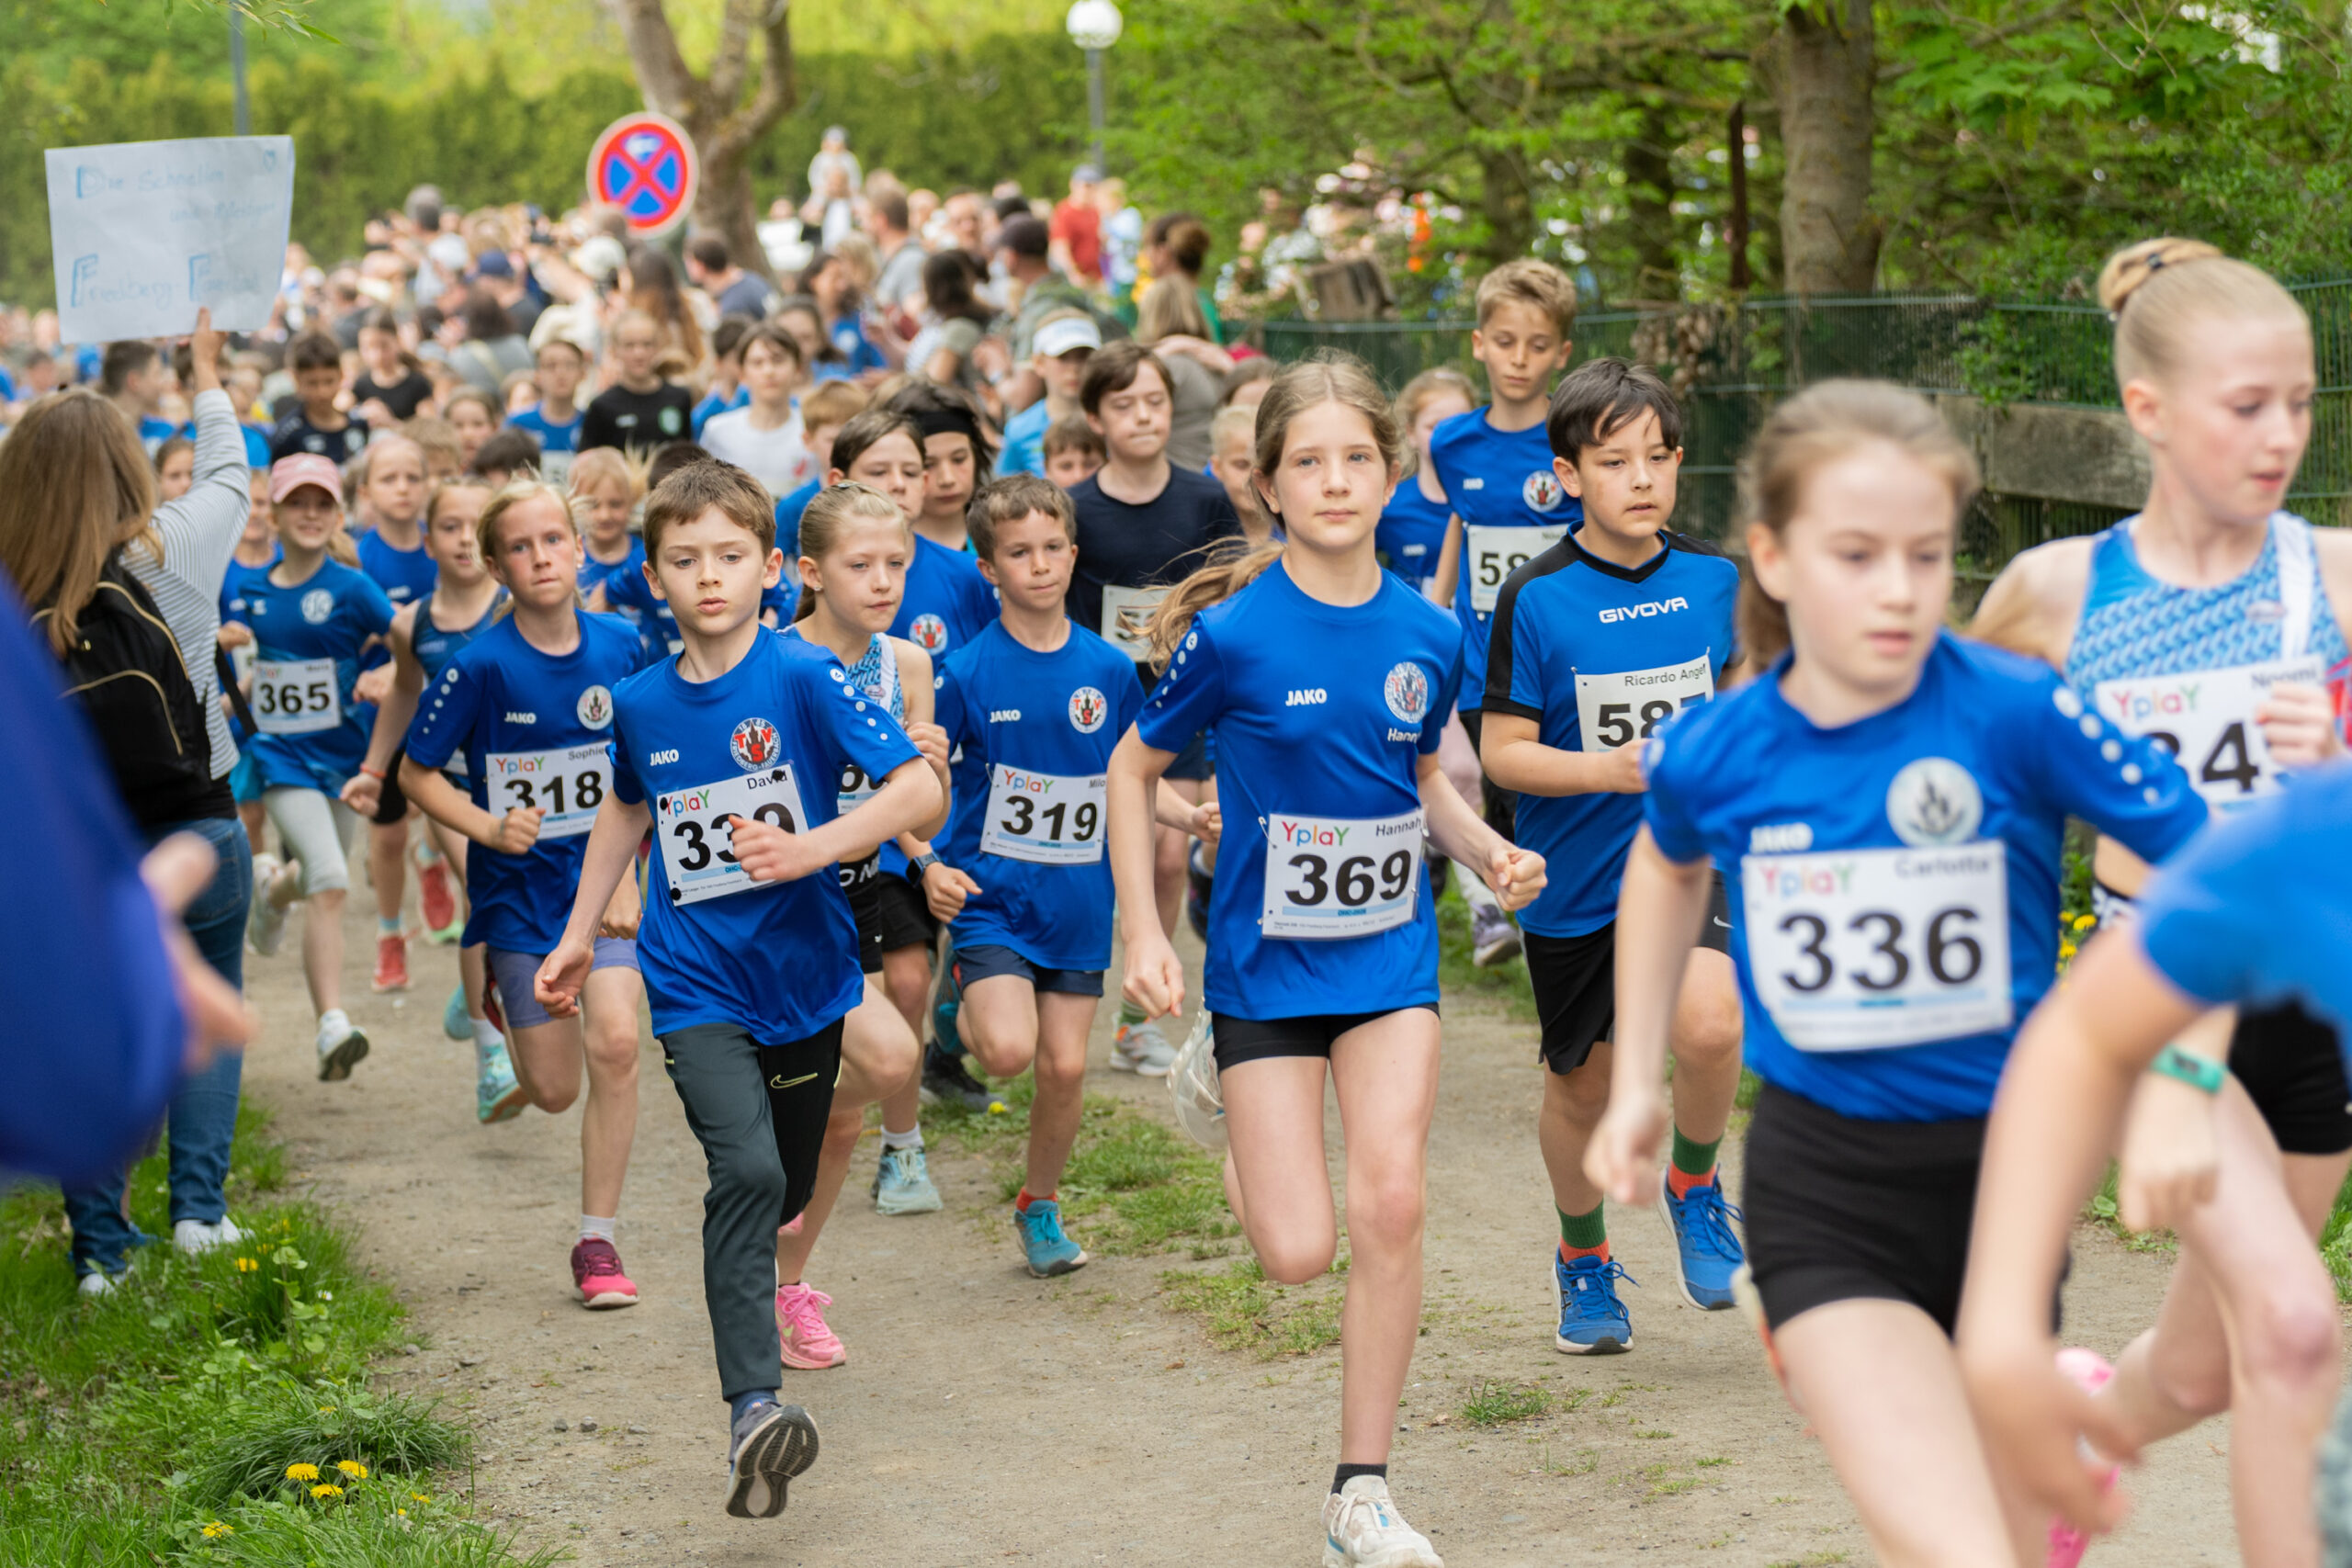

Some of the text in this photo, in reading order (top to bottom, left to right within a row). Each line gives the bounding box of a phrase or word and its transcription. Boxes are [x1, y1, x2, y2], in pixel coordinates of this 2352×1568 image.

[1599, 597, 1689, 623] GIVOVA
[1624, 672, 1677, 687] Ricardo
[259, 682, 330, 714] 365
[1285, 688, 1328, 706] JAKO
[2112, 683, 2199, 721] YplaY
[504, 712, 537, 724] JAKO
[989, 709, 1022, 723] JAKO
[1387, 728, 1422, 743] Hann
[496, 747, 605, 774] YplaY Sophie
[650, 749, 679, 766] JAKO
[504, 771, 603, 814] 318
[1004, 770, 1055, 794] YplaY
[1001, 795, 1097, 841] 319
[1282, 818, 1422, 846] YplaY Hannah
[1284, 850, 1411, 907] 369
[1760, 863, 1854, 897] YplaY
[1781, 908, 1982, 992] 336
